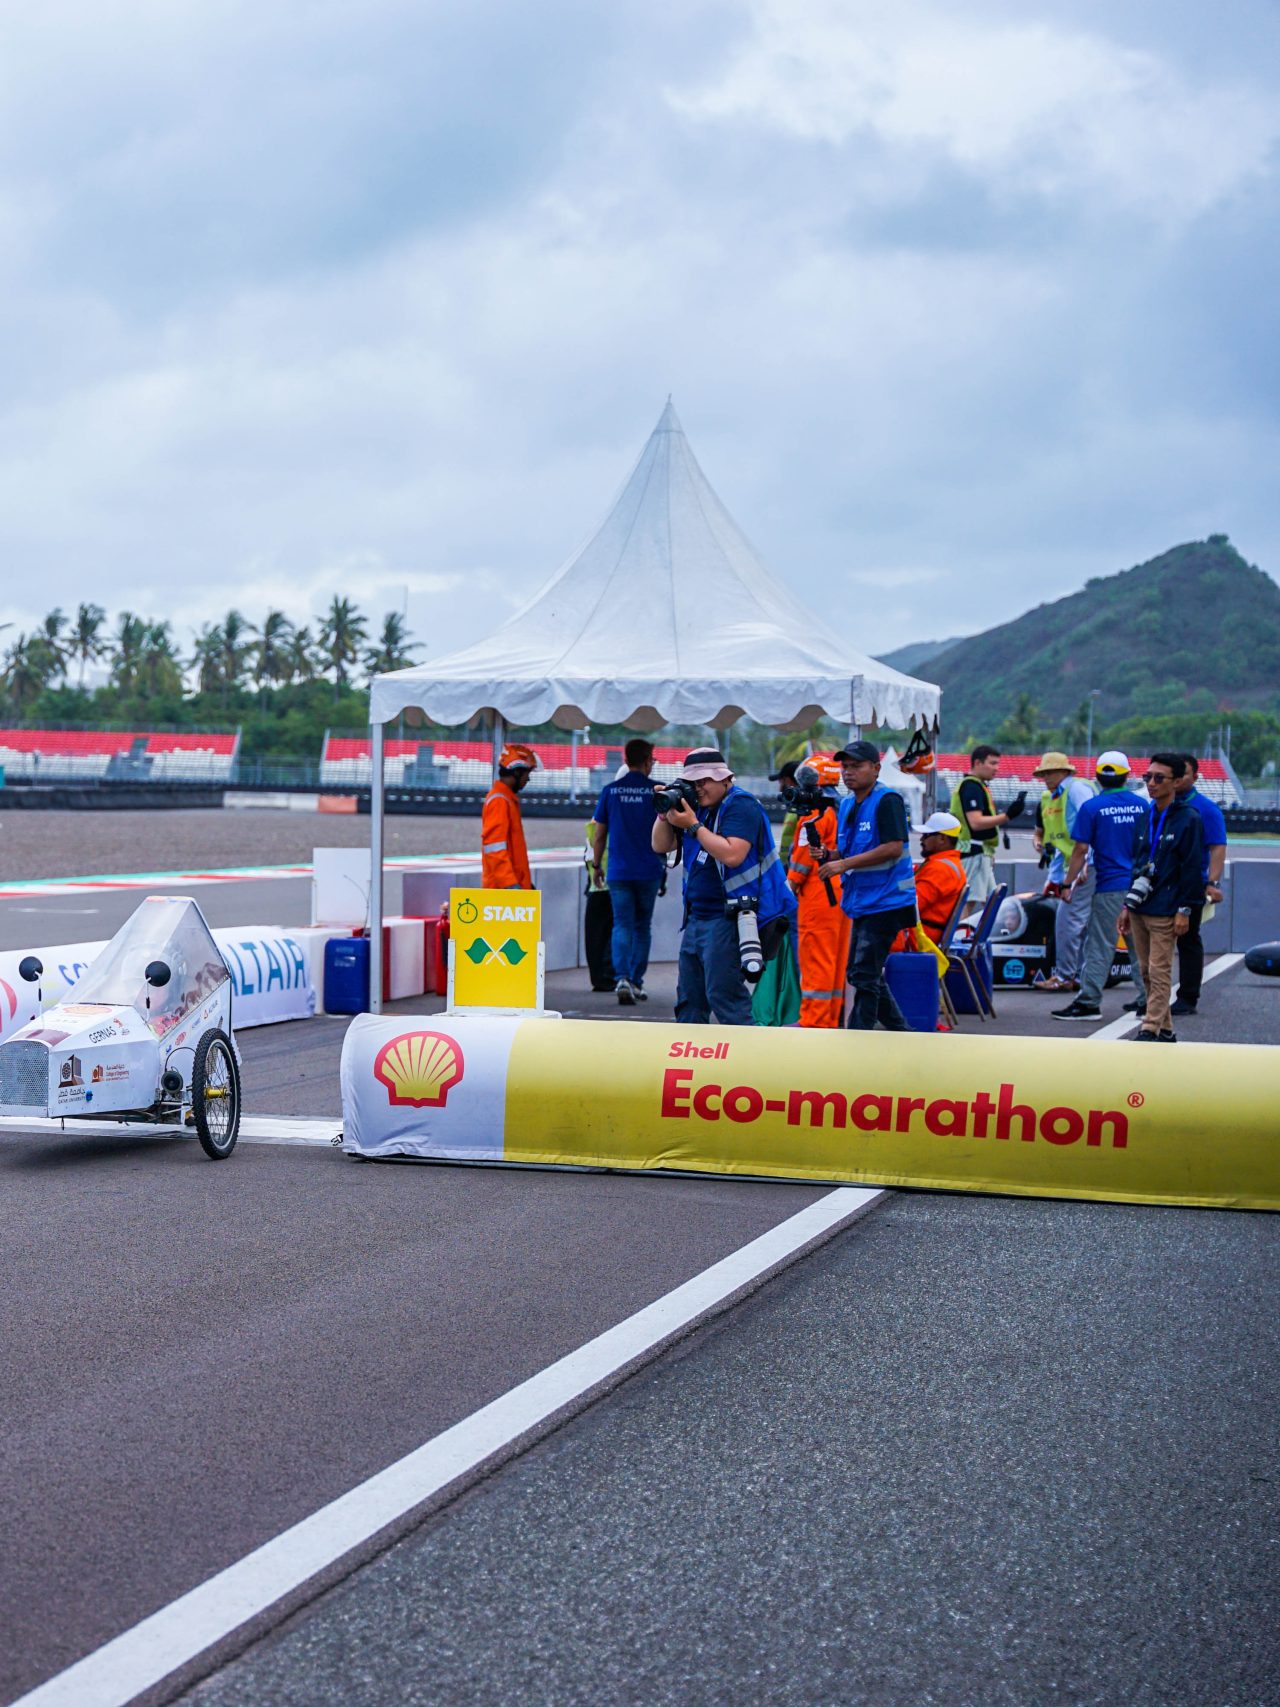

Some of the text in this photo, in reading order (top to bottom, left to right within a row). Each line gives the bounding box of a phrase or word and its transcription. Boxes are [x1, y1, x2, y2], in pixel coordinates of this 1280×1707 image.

[620, 795, 643, 803] TEAM
[1099, 805, 1144, 816] TECHNICAL
[1113, 815, 1135, 824] TEAM
[483, 906, 536, 922] START
[89, 1026, 117, 1043] GERNAS
[668, 1041, 730, 1060] Shell
